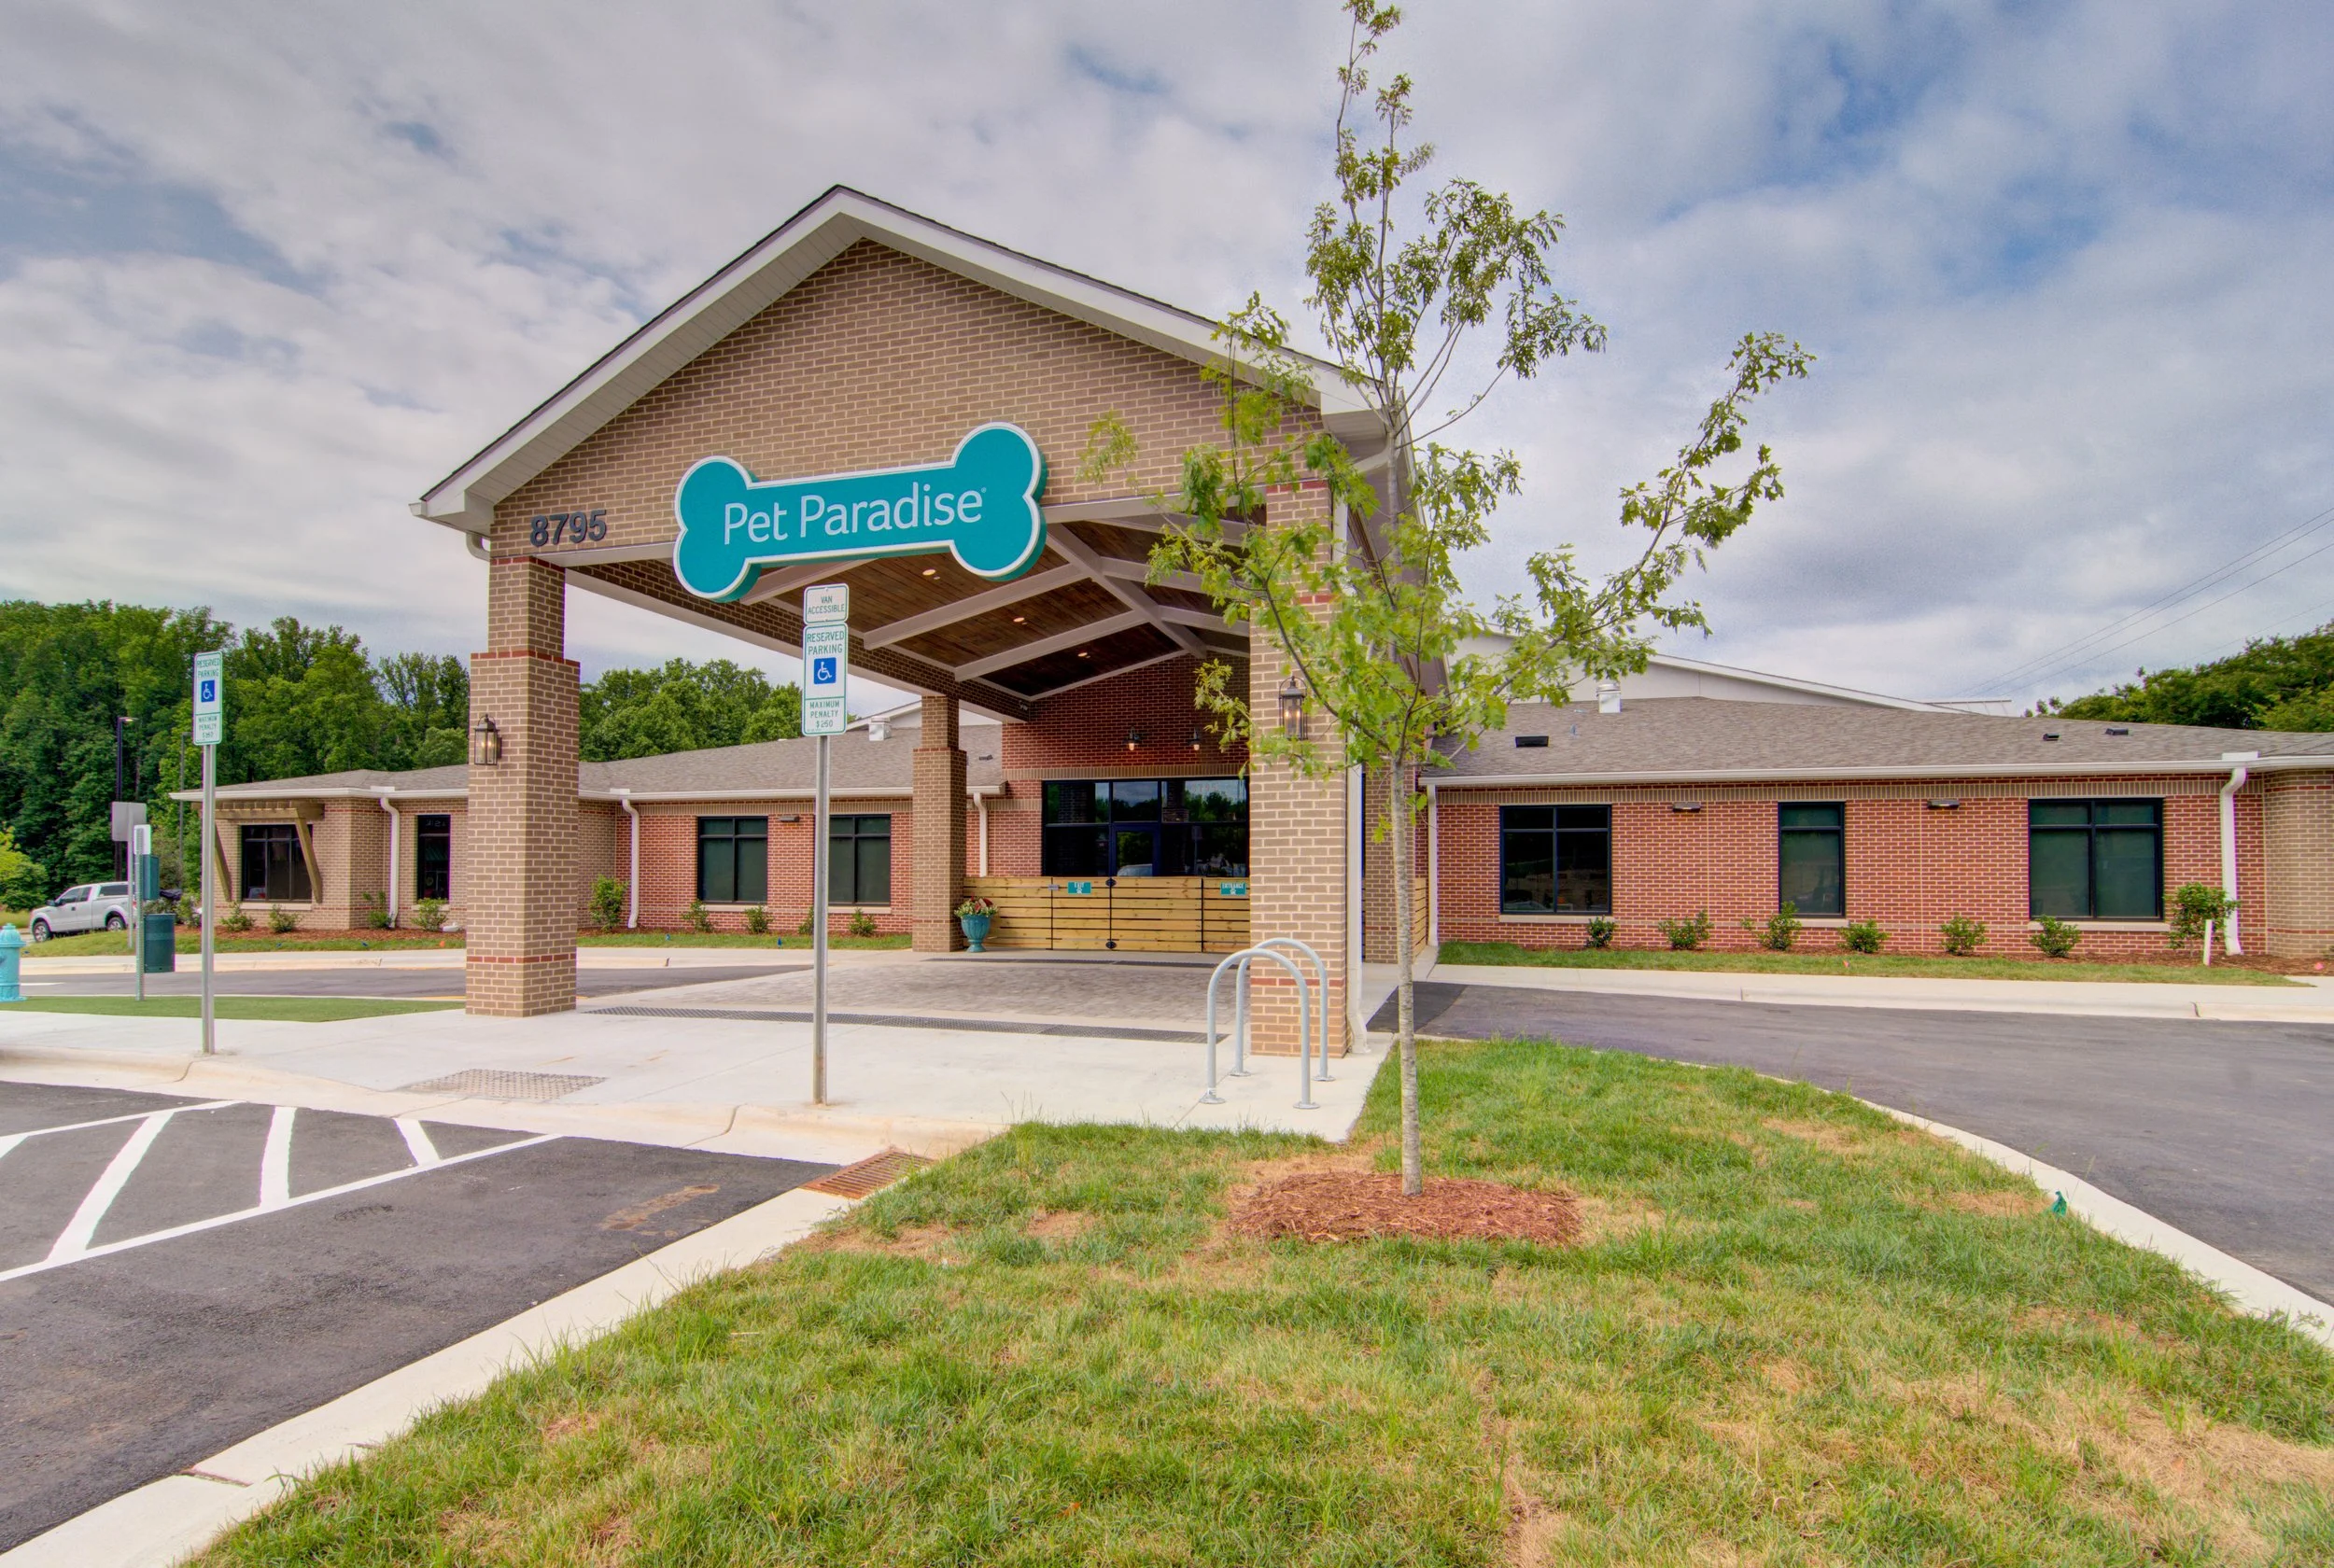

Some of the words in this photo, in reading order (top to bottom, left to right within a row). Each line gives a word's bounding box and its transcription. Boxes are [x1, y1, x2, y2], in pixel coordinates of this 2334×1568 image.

[724, 501, 788, 545] Pet
[529, 509, 607, 548] 8795
[821, 595, 833, 604] VAN
[808, 604, 845, 614] ACCESSIBLE
[807, 631, 845, 643] RESERVED
[808, 644, 843, 655] PARKING
[197, 658, 220, 668] RESERVED
[198, 668, 219, 678] PARKING
[809, 700, 840, 709] MAXIMUM
[815, 720, 834, 728] $250
